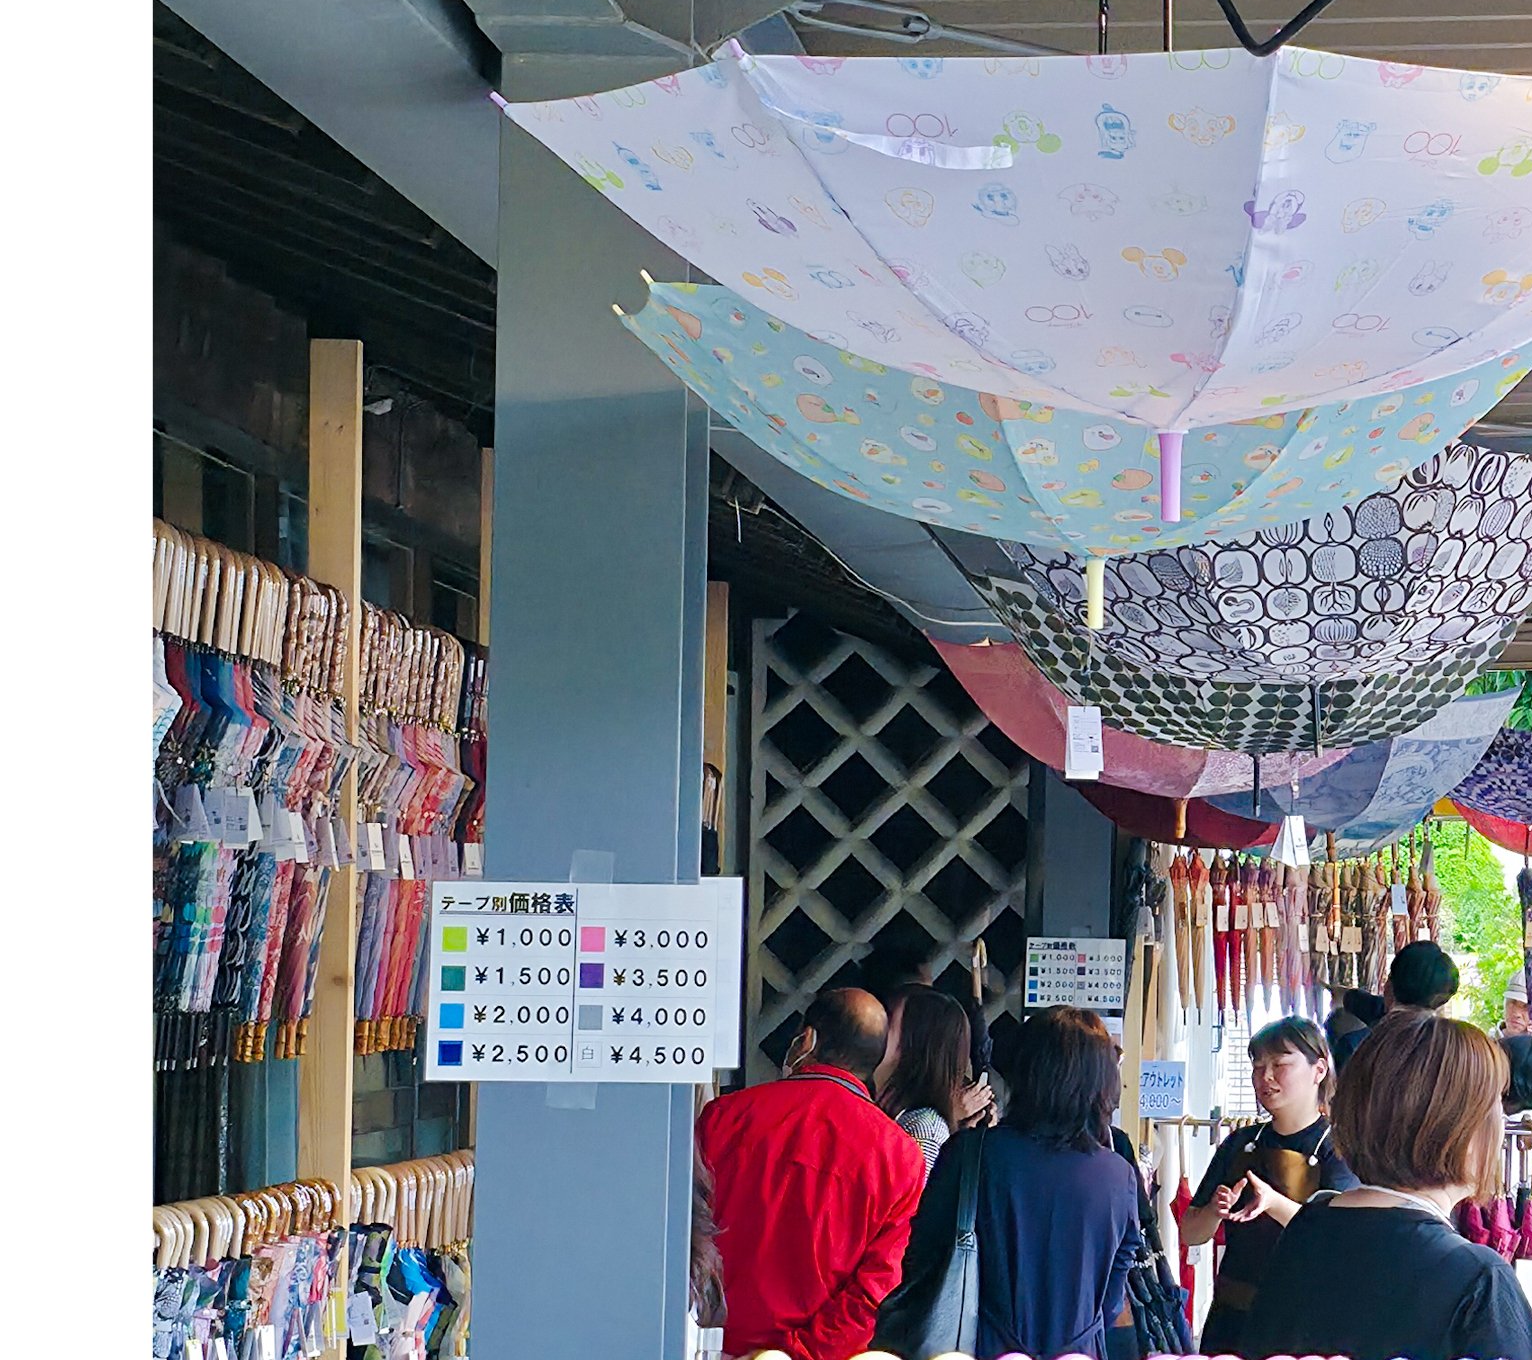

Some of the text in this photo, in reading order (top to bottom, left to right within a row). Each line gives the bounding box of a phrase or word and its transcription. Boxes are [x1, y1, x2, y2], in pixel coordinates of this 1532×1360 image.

[441, 892, 575, 915] テープ別価格表
[476, 928, 572, 948] ¥1,000
[614, 929, 708, 949] ¥3,000
[474, 966, 570, 986] ¥1,500
[613, 968, 707, 988] ¥3,500
[473, 1005, 569, 1025] ¥2,000
[612, 1007, 706, 1027] ¥4,000
[472, 1044, 568, 1064] ¥2,500
[610, 1045, 705, 1065] ¥4,500
